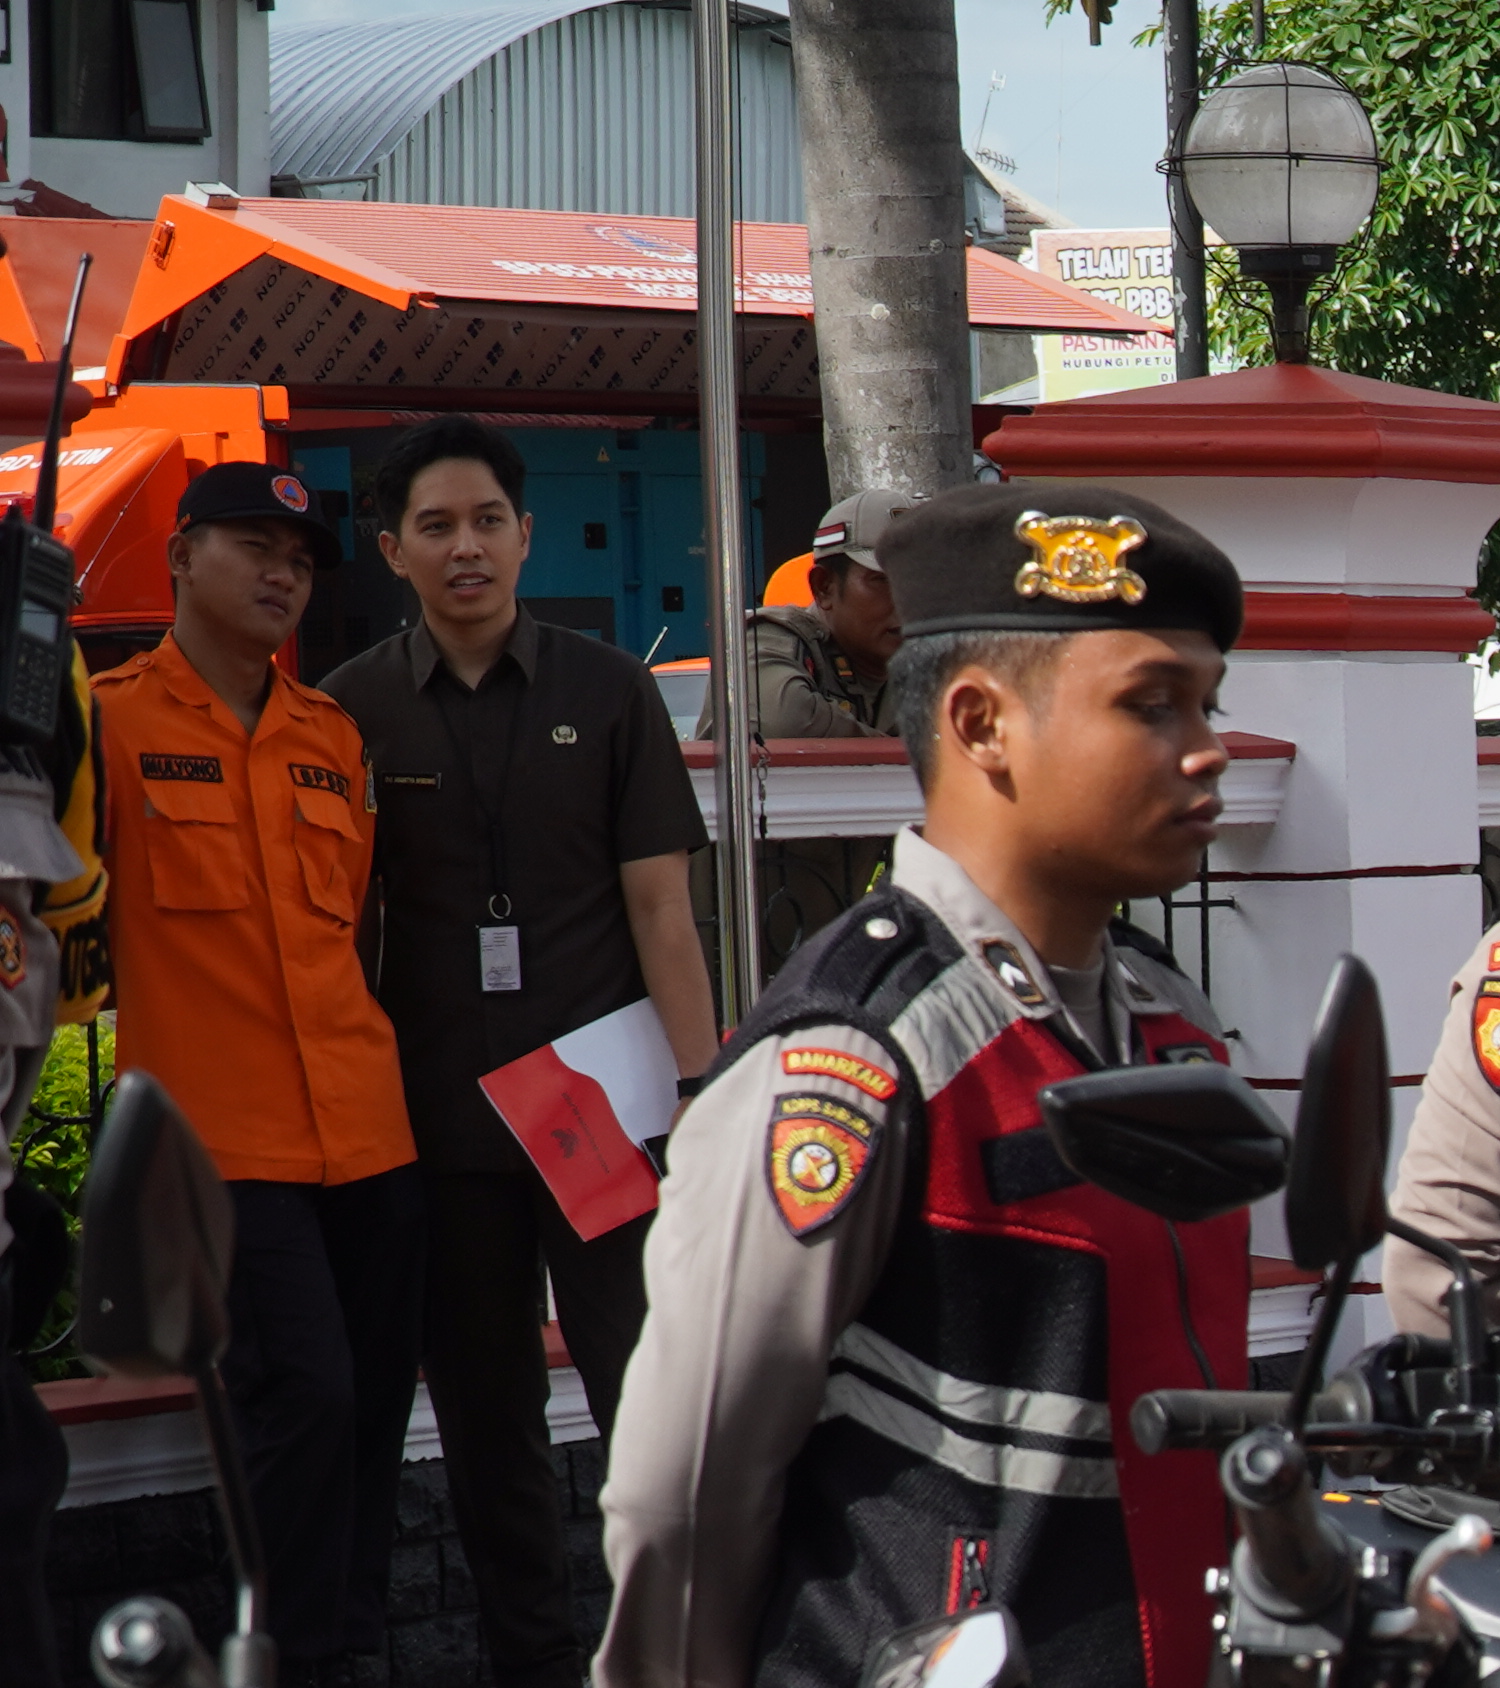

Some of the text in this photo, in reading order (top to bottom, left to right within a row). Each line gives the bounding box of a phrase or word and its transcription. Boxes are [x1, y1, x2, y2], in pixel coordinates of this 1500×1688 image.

[1057, 246, 1130, 281] TELAH
[1063, 356, 1130, 368] HUBUNGI
[1135, 355, 1173, 367] PETU
